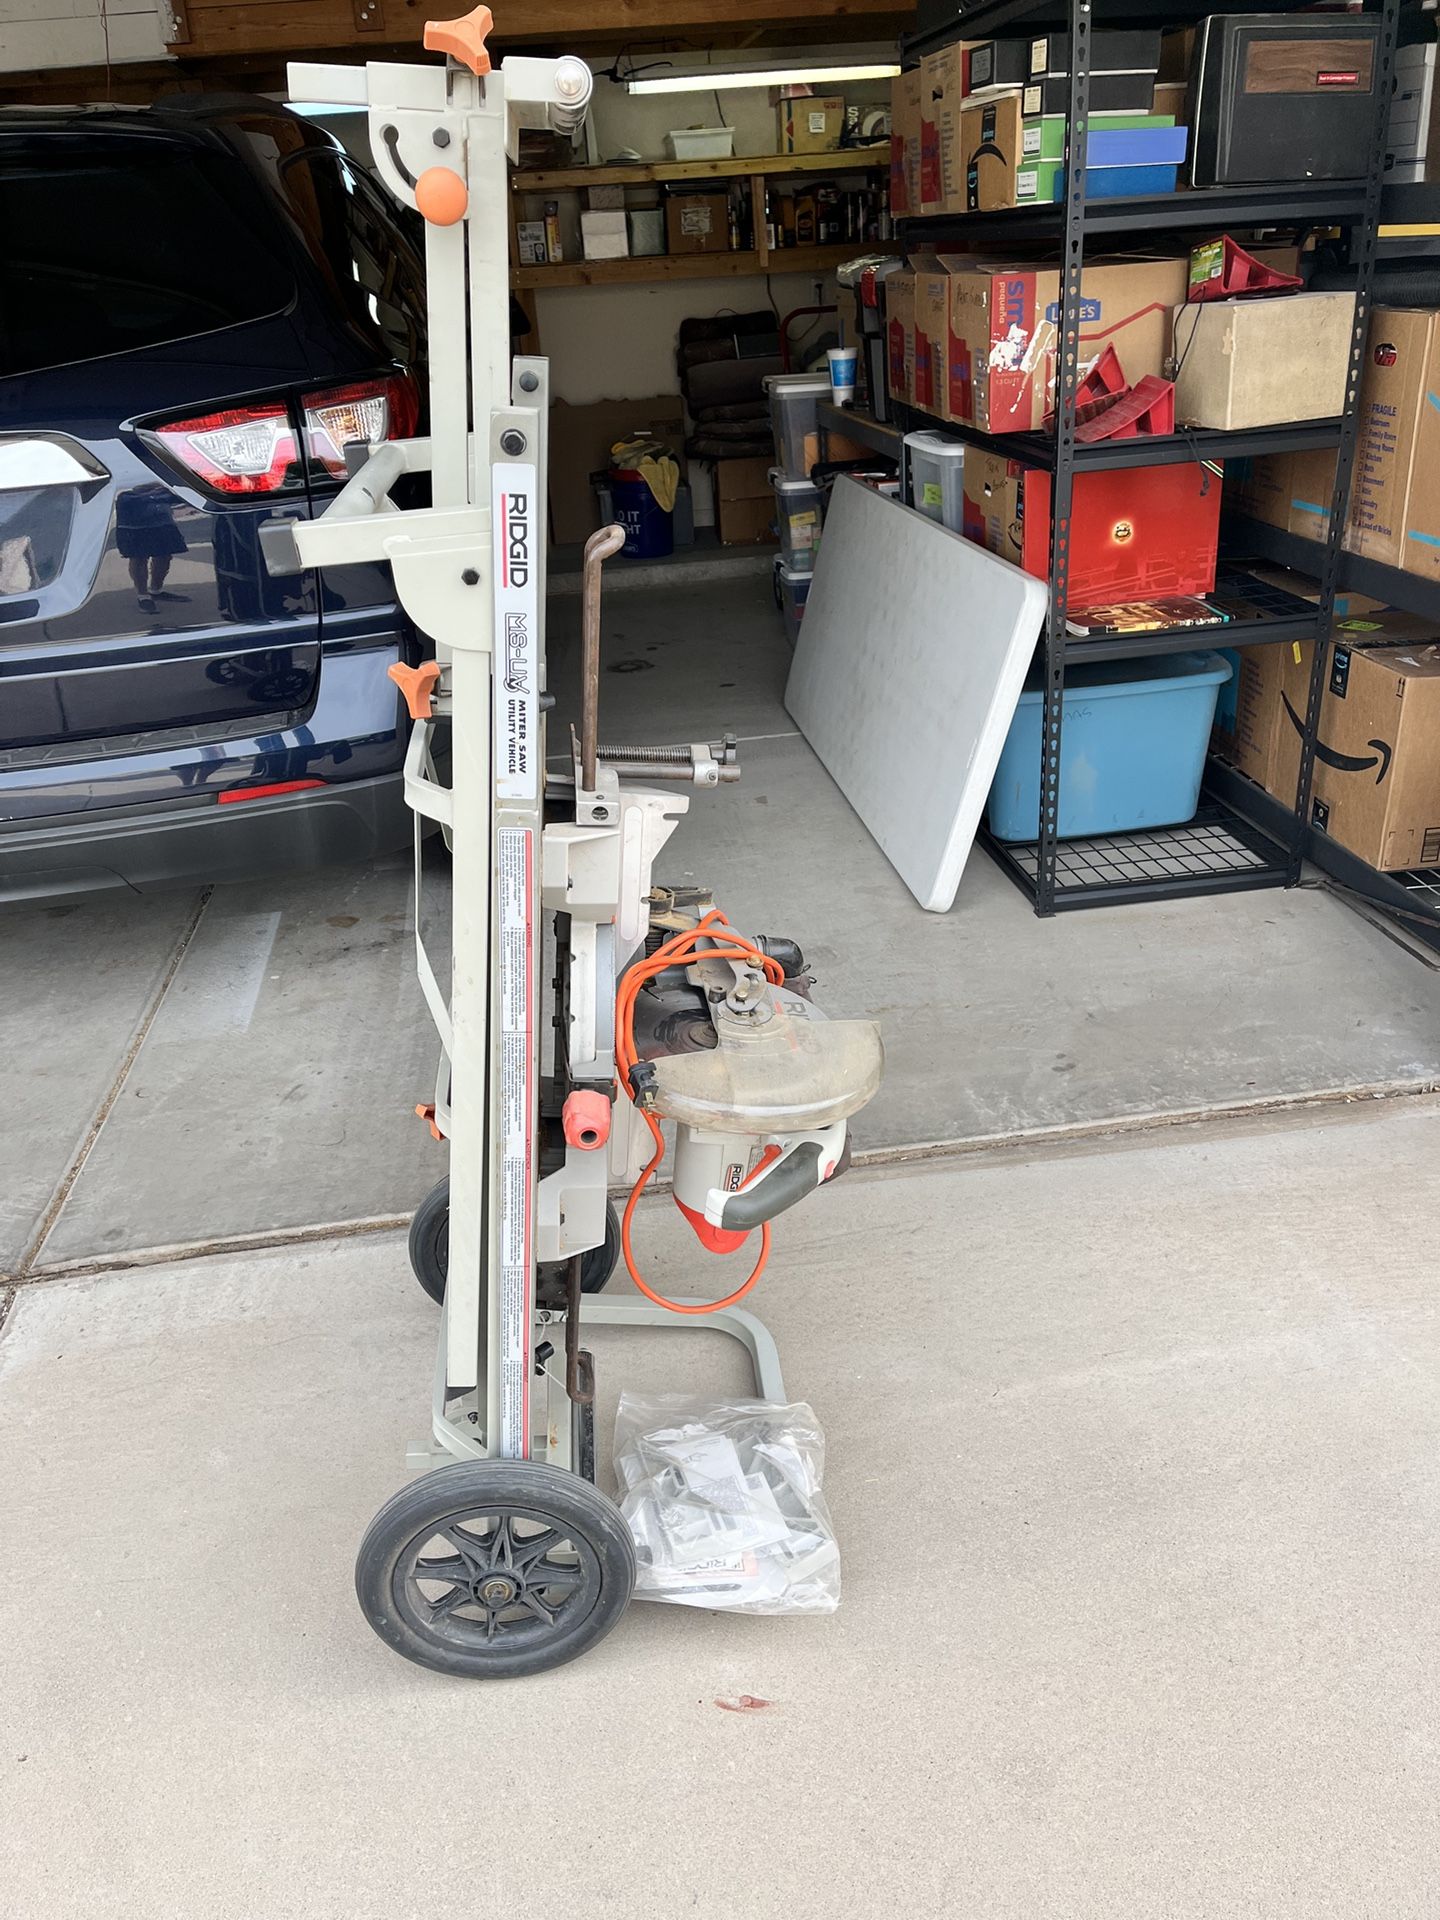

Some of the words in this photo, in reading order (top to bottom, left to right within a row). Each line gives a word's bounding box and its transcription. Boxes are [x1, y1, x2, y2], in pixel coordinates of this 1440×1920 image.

[998, 281, 1007, 324] pequeña
[1051, 303, 1096, 321] LE'S
[1371, 403, 1398, 417] FRAGILE
[1368, 429, 1383, 440] Family
[1383, 431, 1397, 441] Room
[1381, 443, 1395, 453] Room
[1365, 452, 1382, 463] Kitchen
[509, 493, 528, 588] RIDGID
[508, 737, 516, 774] VEHICLE
[519, 745, 527, 774] SAW
